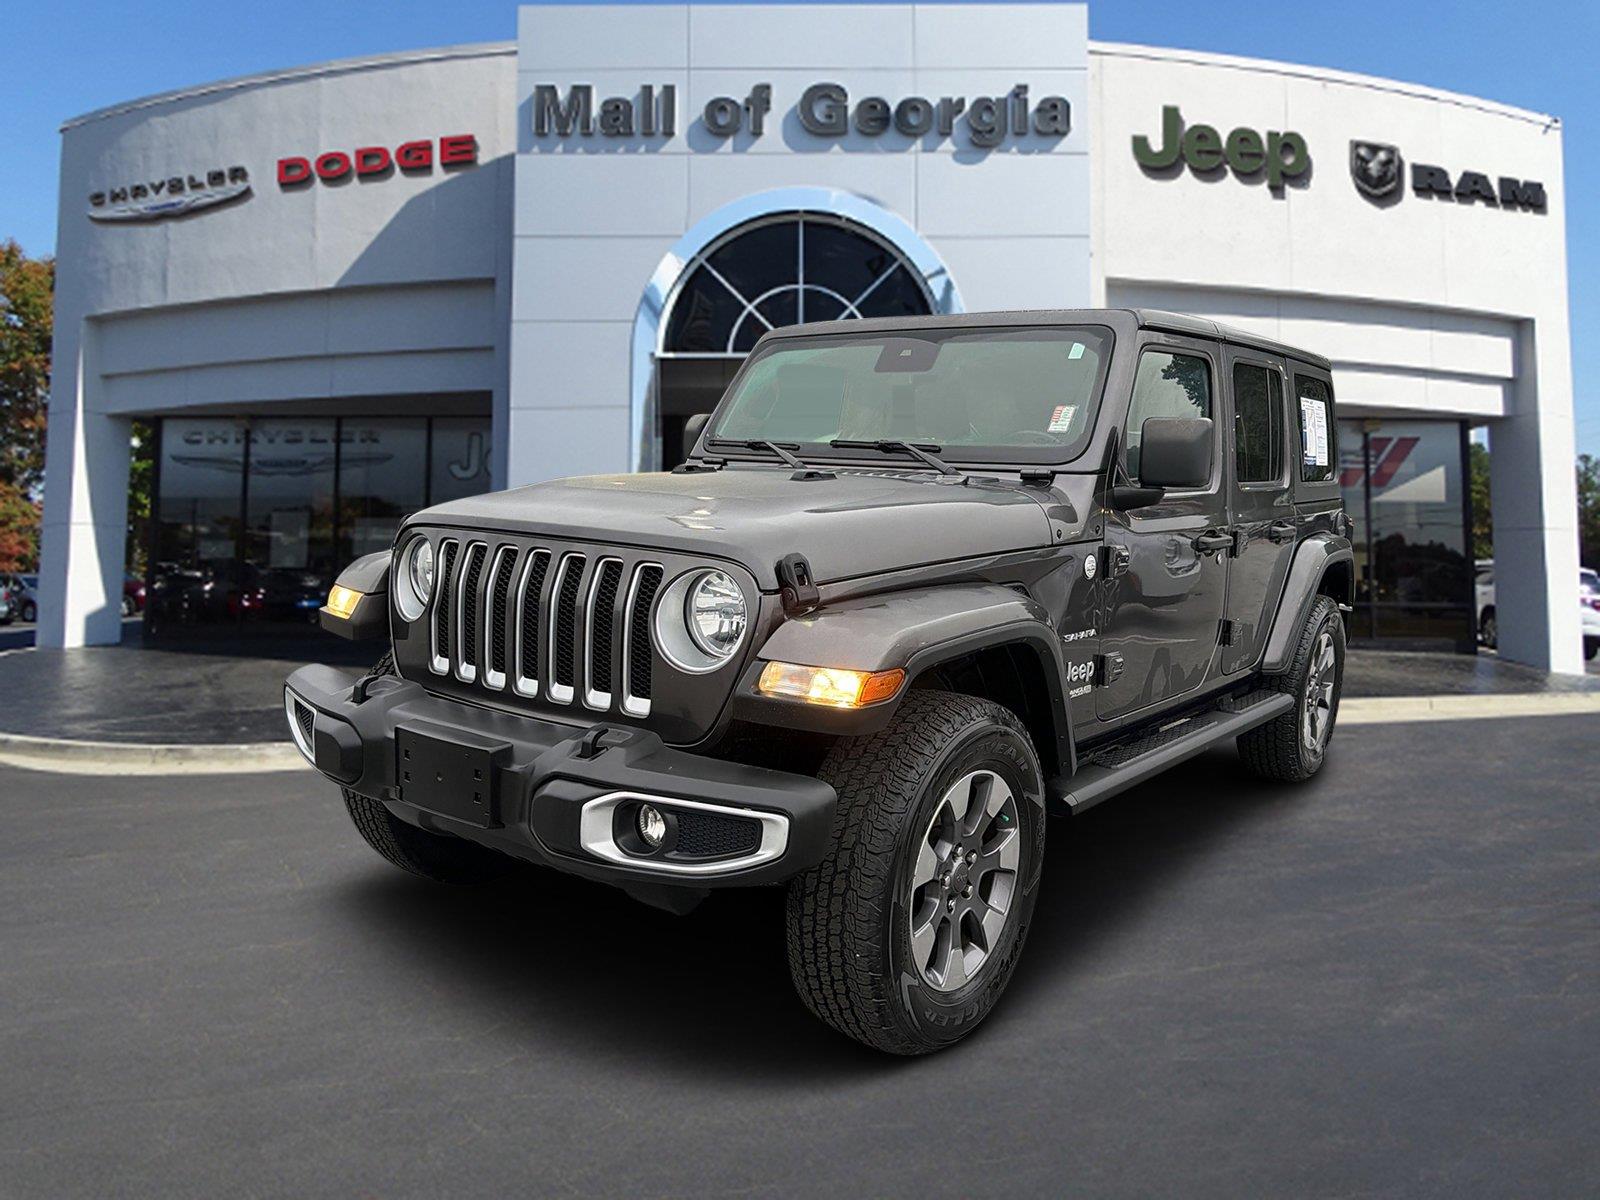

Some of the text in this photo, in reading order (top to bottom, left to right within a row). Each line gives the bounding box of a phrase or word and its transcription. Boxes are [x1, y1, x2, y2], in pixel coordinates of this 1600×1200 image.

[532, 82, 1072, 149] Mall of Georgia
[276, 133, 479, 188] DODGE
[1131, 104, 1309, 192] Jeep
[89, 165, 250, 208] CHRYSLER
[1410, 162, 1548, 214] RAM
[182, 429, 381, 445] CHRYSLER
[1063, 628, 1097, 643] SAHARA
[1066, 660, 1095, 682] Jeep
